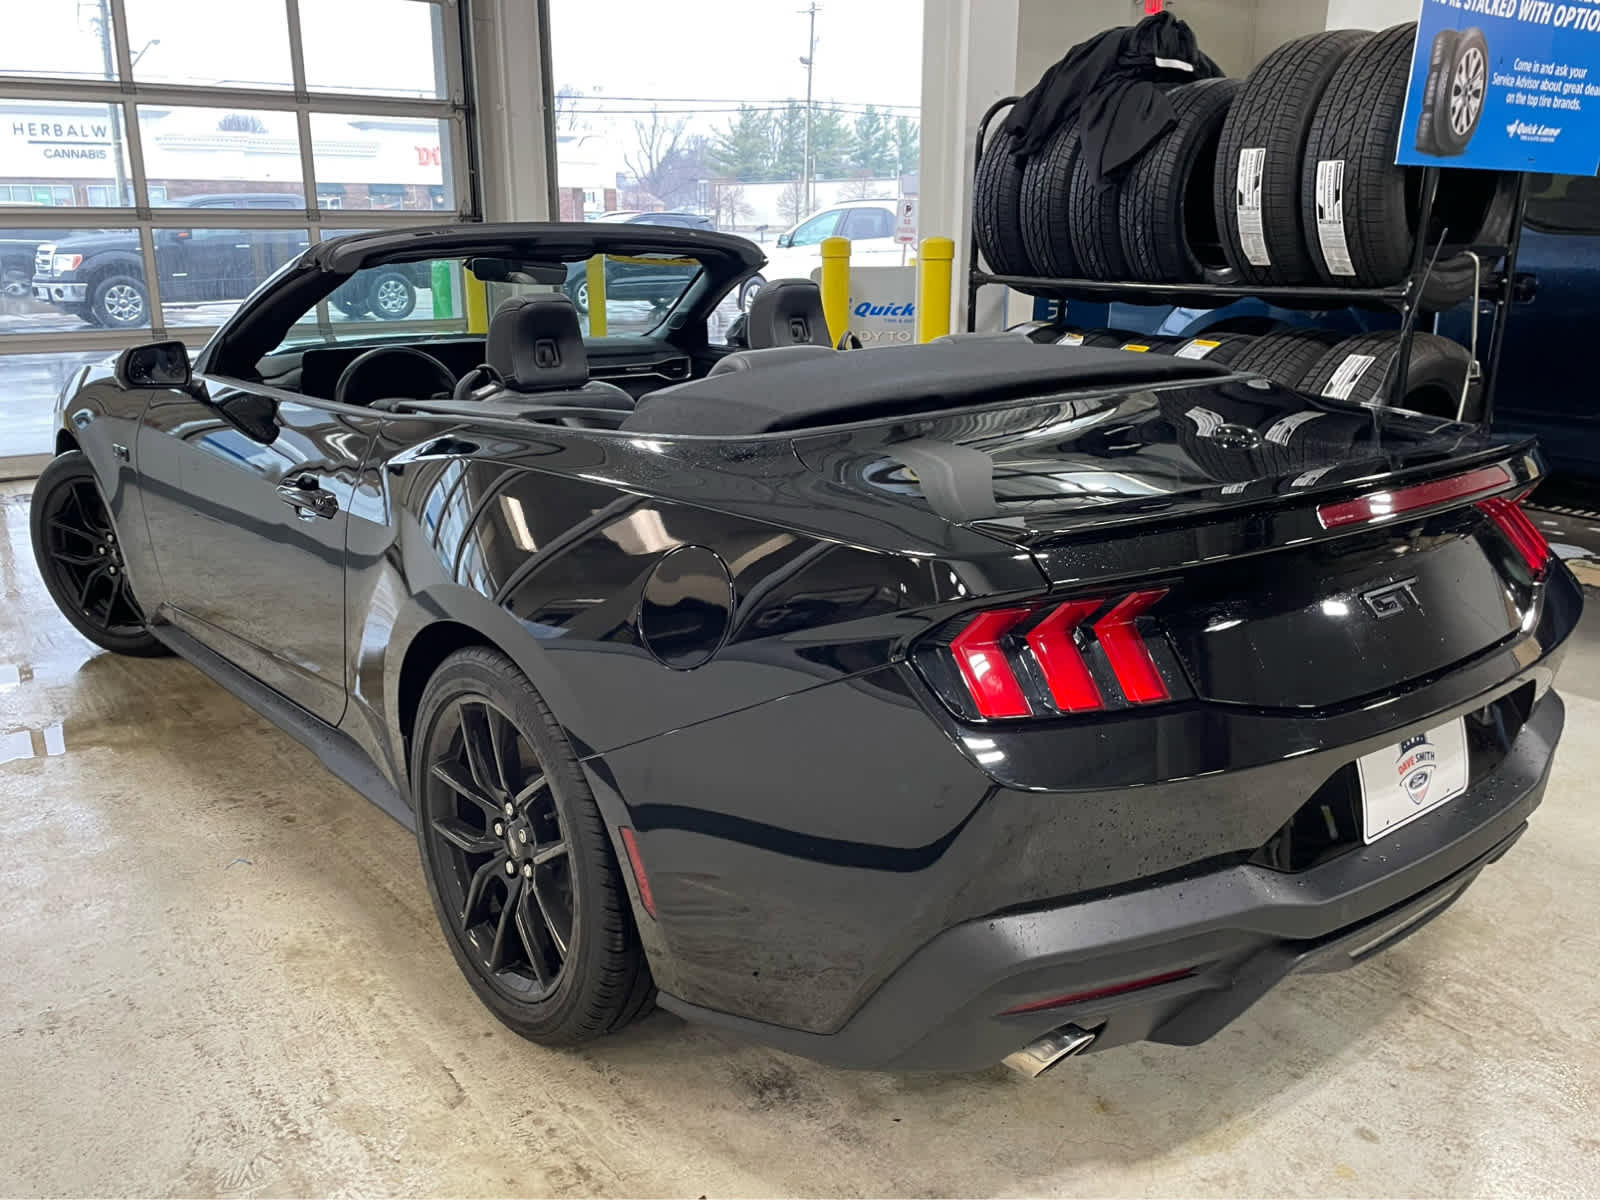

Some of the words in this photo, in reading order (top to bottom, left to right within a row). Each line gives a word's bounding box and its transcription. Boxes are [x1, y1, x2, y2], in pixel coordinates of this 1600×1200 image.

[1464, 0, 1516, 18] STACKED
[1518, 0, 1554, 25] WITH
[1553, 5, 1600, 33] OPTIO
[1514, 58, 1533, 72] Come
[1533, 61, 1540, 73] in
[1540, 62, 1555, 75] and
[1555, 64, 1568, 76] ask
[1568, 68, 1588, 80] your
[1492, 72, 1515, 87] Service
[1515, 75, 1540, 90] Advisor
[1540, 79, 1562, 92] about
[1562, 82, 1584, 95] great
[1506, 93, 1515, 104] on
[1515, 91, 1526, 105] the
[1527, 94, 1538, 108] top
[1539, 95, 1552, 107] tire
[1552, 96, 1581, 110] brands.
[12, 122, 107, 138] HERBALW
[43, 148, 107, 160] CANNABIS
[854, 302, 915, 318] Quick
[1359, 576, 1422, 618] GT
[1398, 755, 1415, 775] DAVE
[1416, 751, 1435, 764] SMITH
